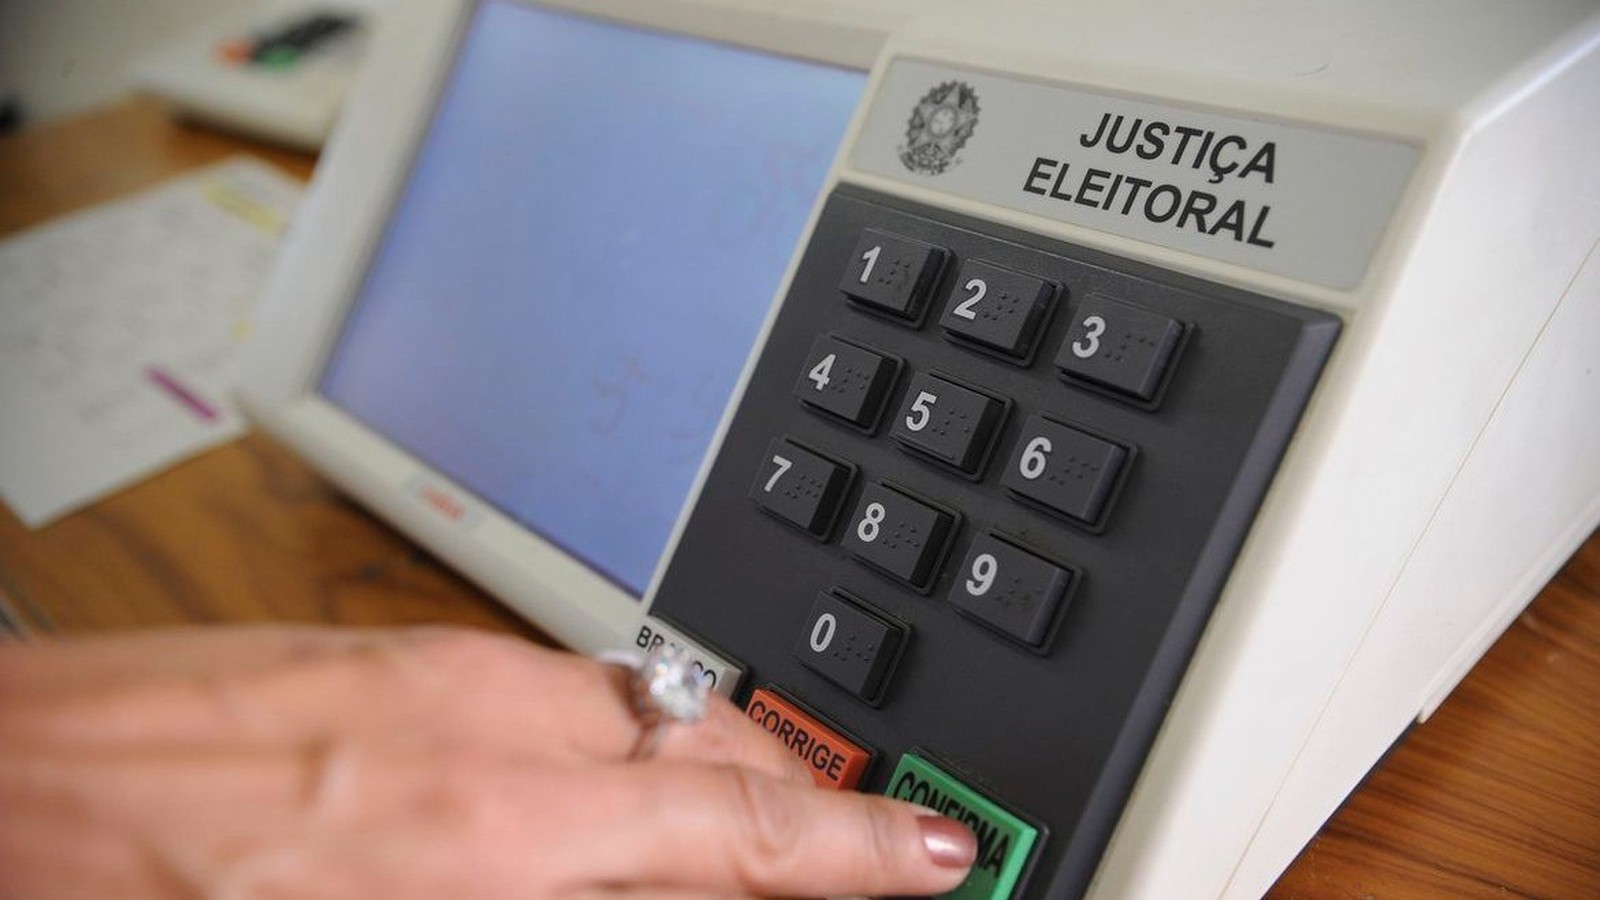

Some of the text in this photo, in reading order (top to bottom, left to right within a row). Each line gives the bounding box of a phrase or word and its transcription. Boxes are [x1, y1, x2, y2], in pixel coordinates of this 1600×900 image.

[1079, 112, 1277, 184] JUSTIÇA
[1023, 157, 1276, 249] ELEITORAL
[859, 245, 881, 283] 1
[952, 278, 987, 320] 2
[1071, 315, 1106, 358] 3
[808, 353, 836, 390] 4
[905, 391, 937, 432] 5
[764, 455, 793, 492] 7
[1019, 436, 1052, 479] 6
[856, 502, 886, 543] 8
[965, 553, 998, 596] 9
[809, 612, 837, 653] 0
[748, 700, 847, 782] CORRIGE
